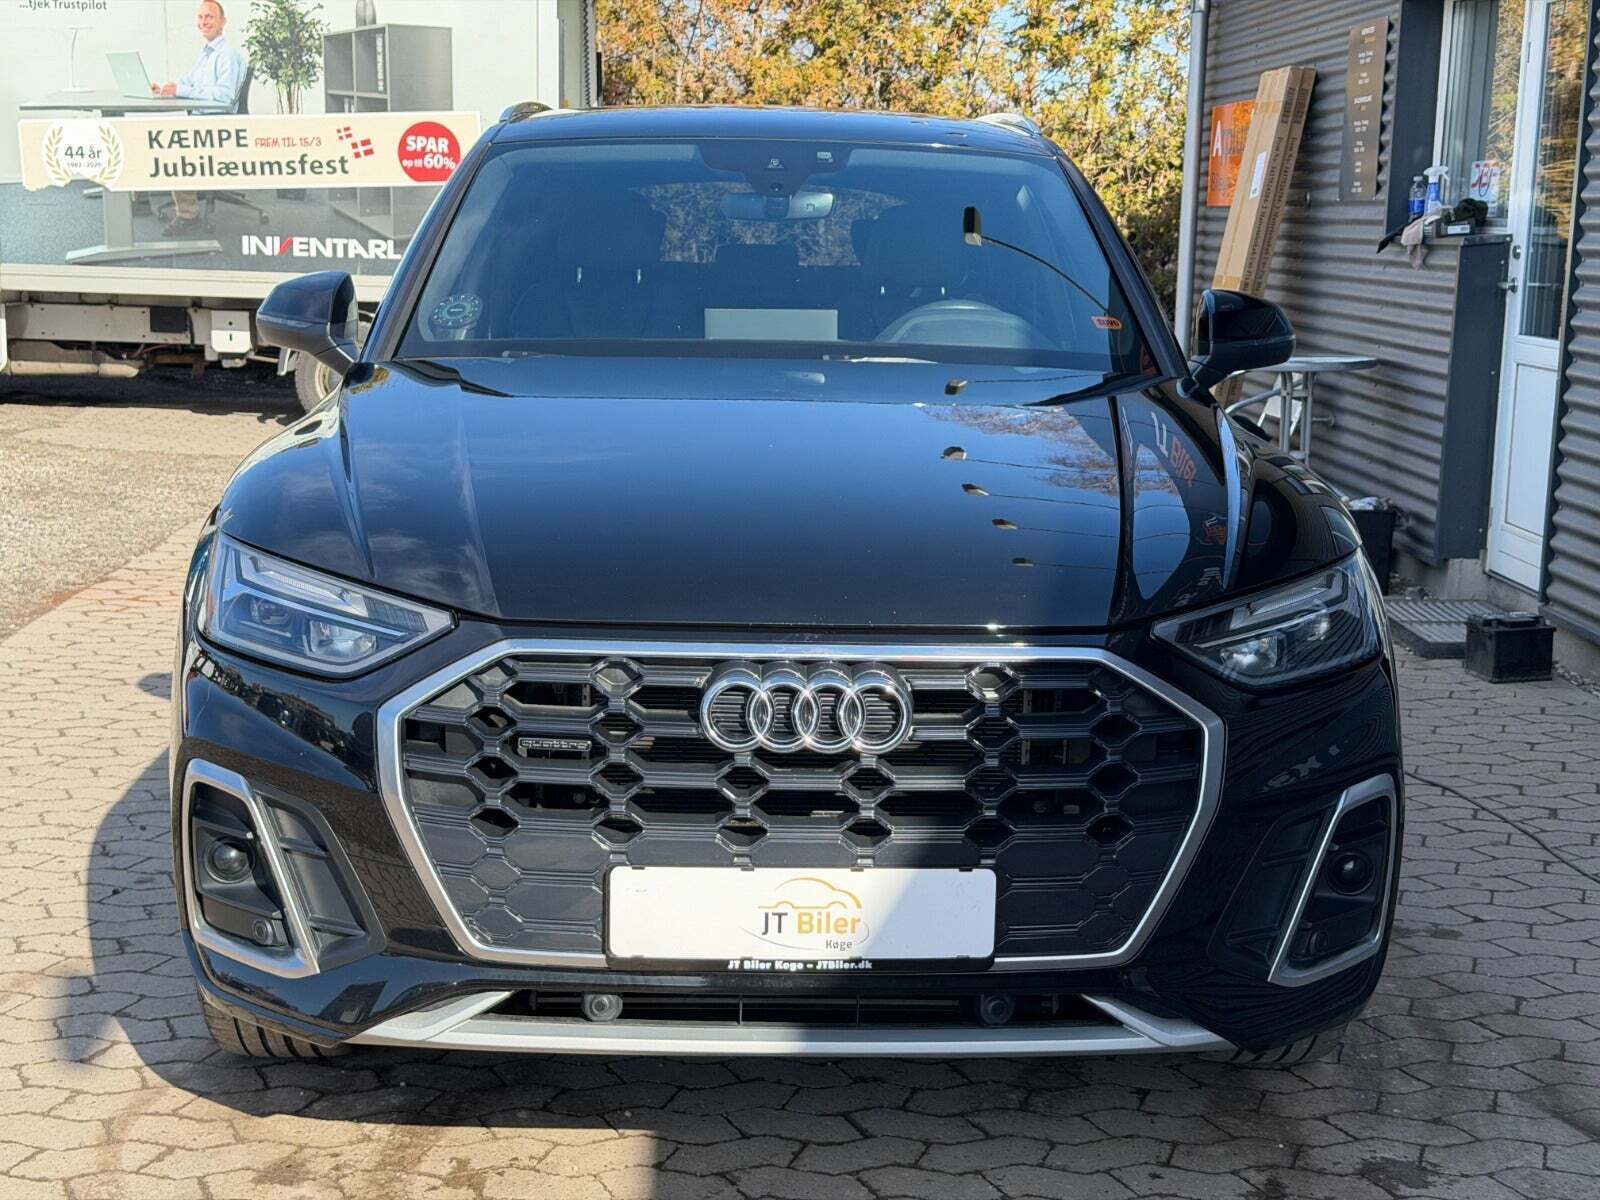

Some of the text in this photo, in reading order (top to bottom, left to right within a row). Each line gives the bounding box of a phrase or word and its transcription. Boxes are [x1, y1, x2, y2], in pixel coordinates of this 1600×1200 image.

[54, 0, 107, 12] Trustpilot
[148, 128, 322, 149] KÆMPE FREM TIL 15/3
[406, 135, 449, 154] SPAR
[64, 145, 102, 159] 44 år
[150, 153, 350, 178] Jubilæumsfest
[424, 152, 456, 170] 60%
[521, 739, 588, 750] quattro
[762, 911, 861, 936] JT Biler
[825, 939, 853, 951] Køge
[728, 960, 740, 970] JT
[743, 960, 772, 970] Biler
[816, 960, 873, 970] JTBiler.dk
